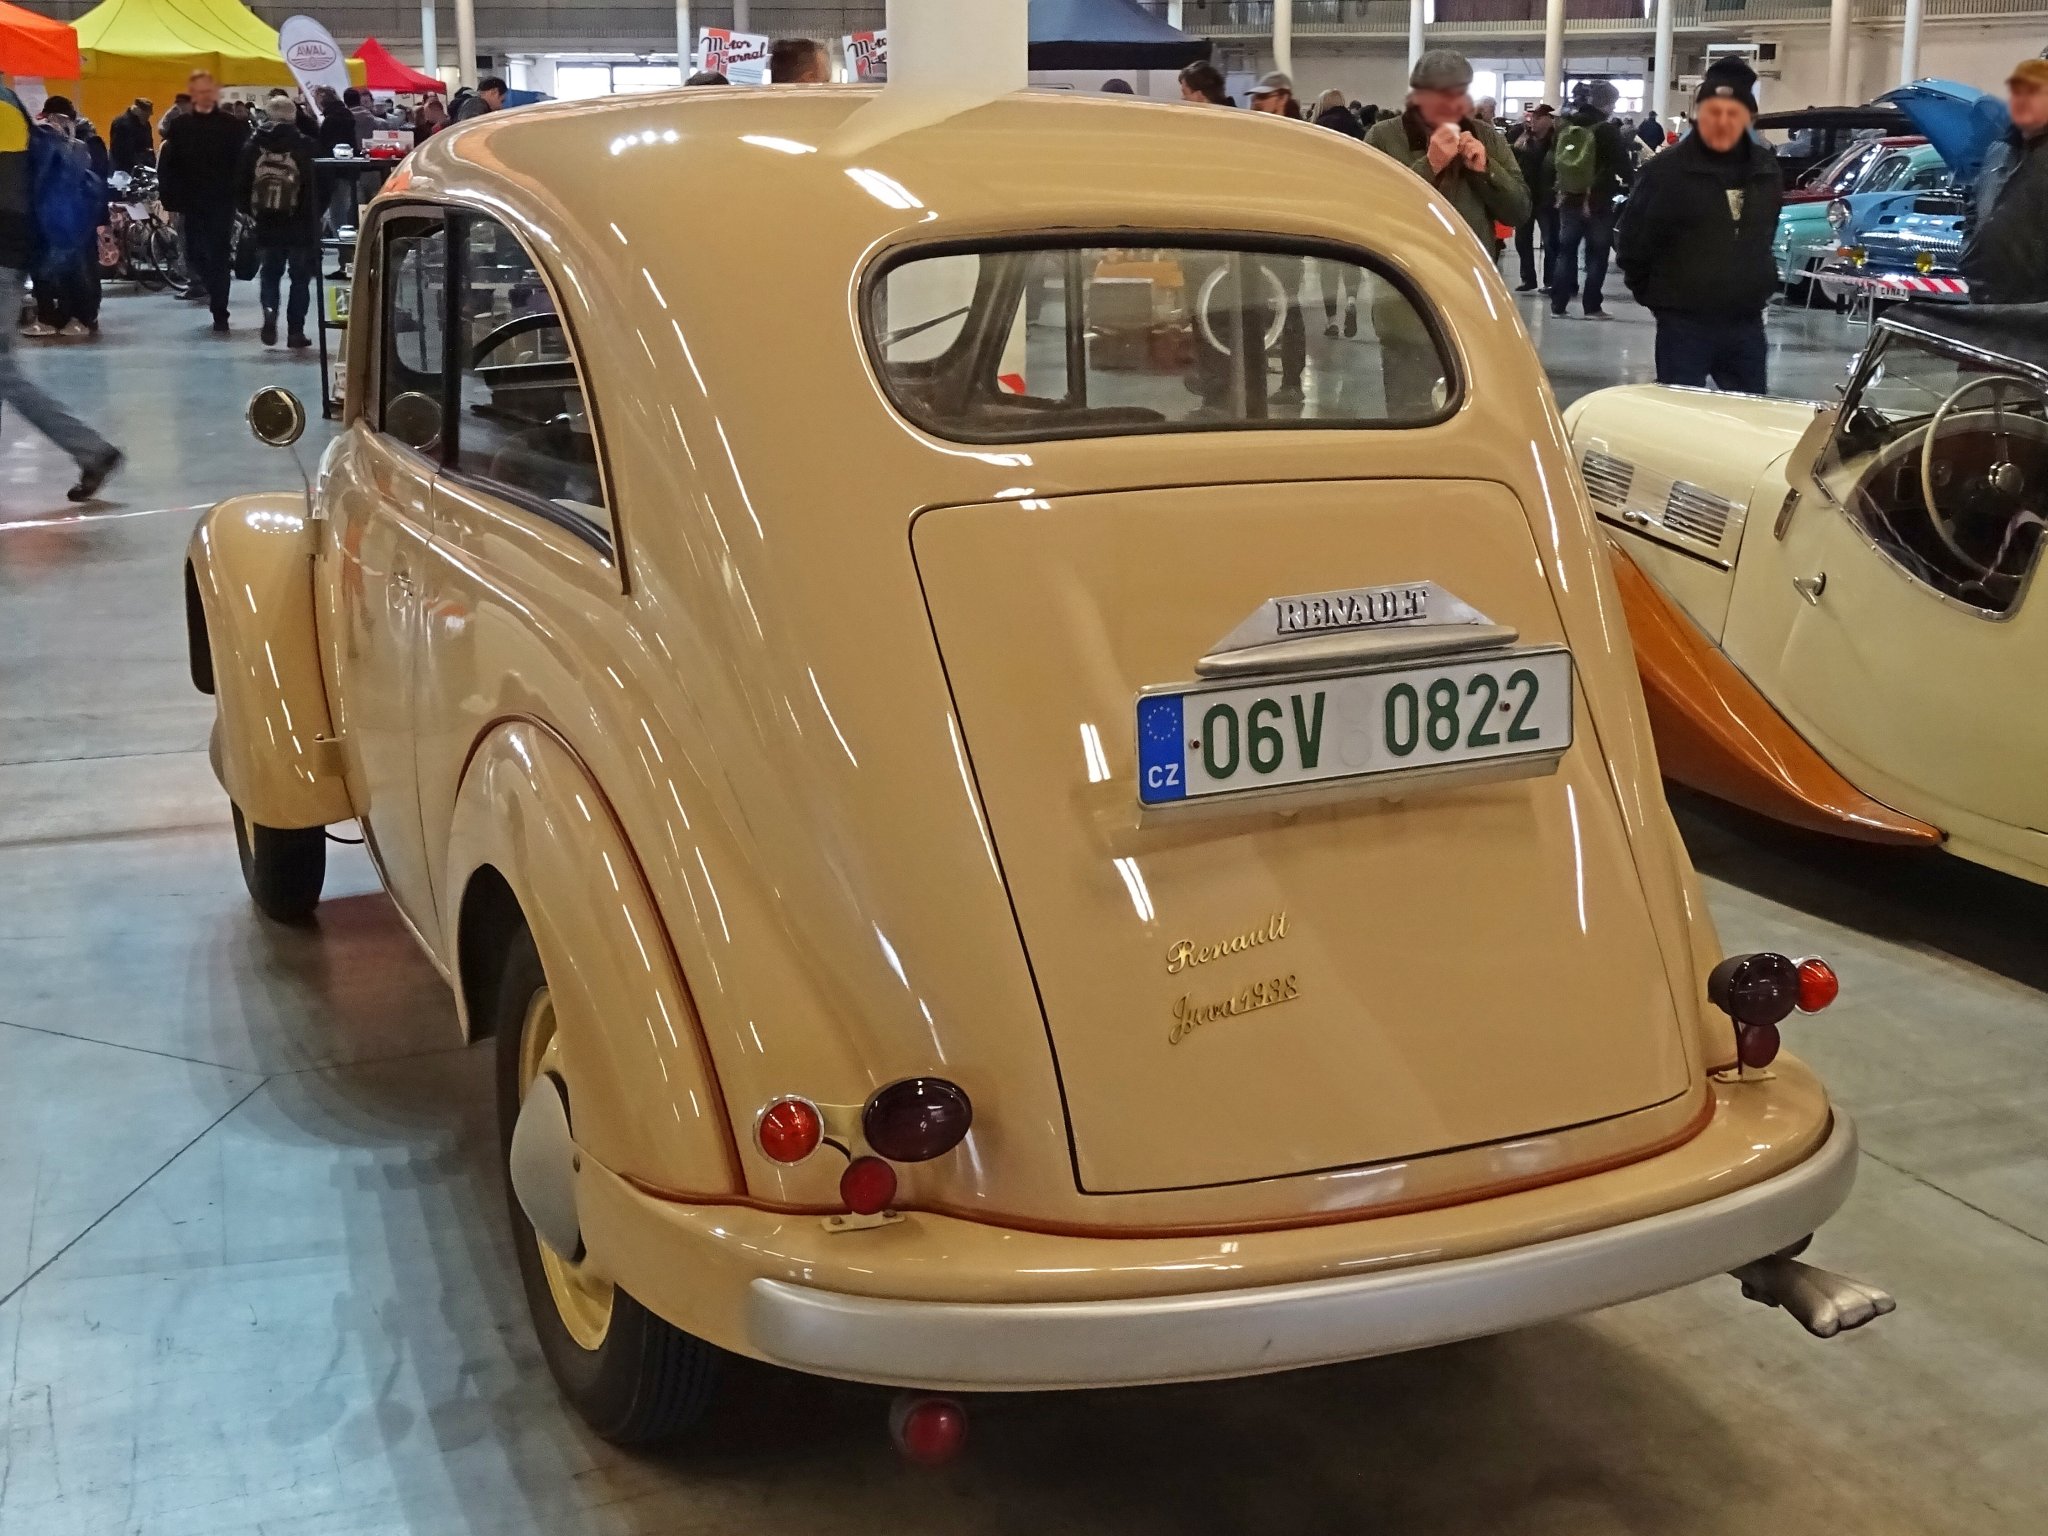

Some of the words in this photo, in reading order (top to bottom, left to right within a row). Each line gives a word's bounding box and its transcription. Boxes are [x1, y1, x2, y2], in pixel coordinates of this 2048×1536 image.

[701, 37, 752, 53] Motor
[713, 41, 767, 72] Journal
[847, 37, 887, 58] Moto
[1275, 587, 1430, 635] RENAULT
[1202, 691, 1326, 780] 06V
[1385, 668, 1540, 757] 0822
[1148, 763, 1180, 788] CZ
[1166, 911, 1291, 974] Renault
